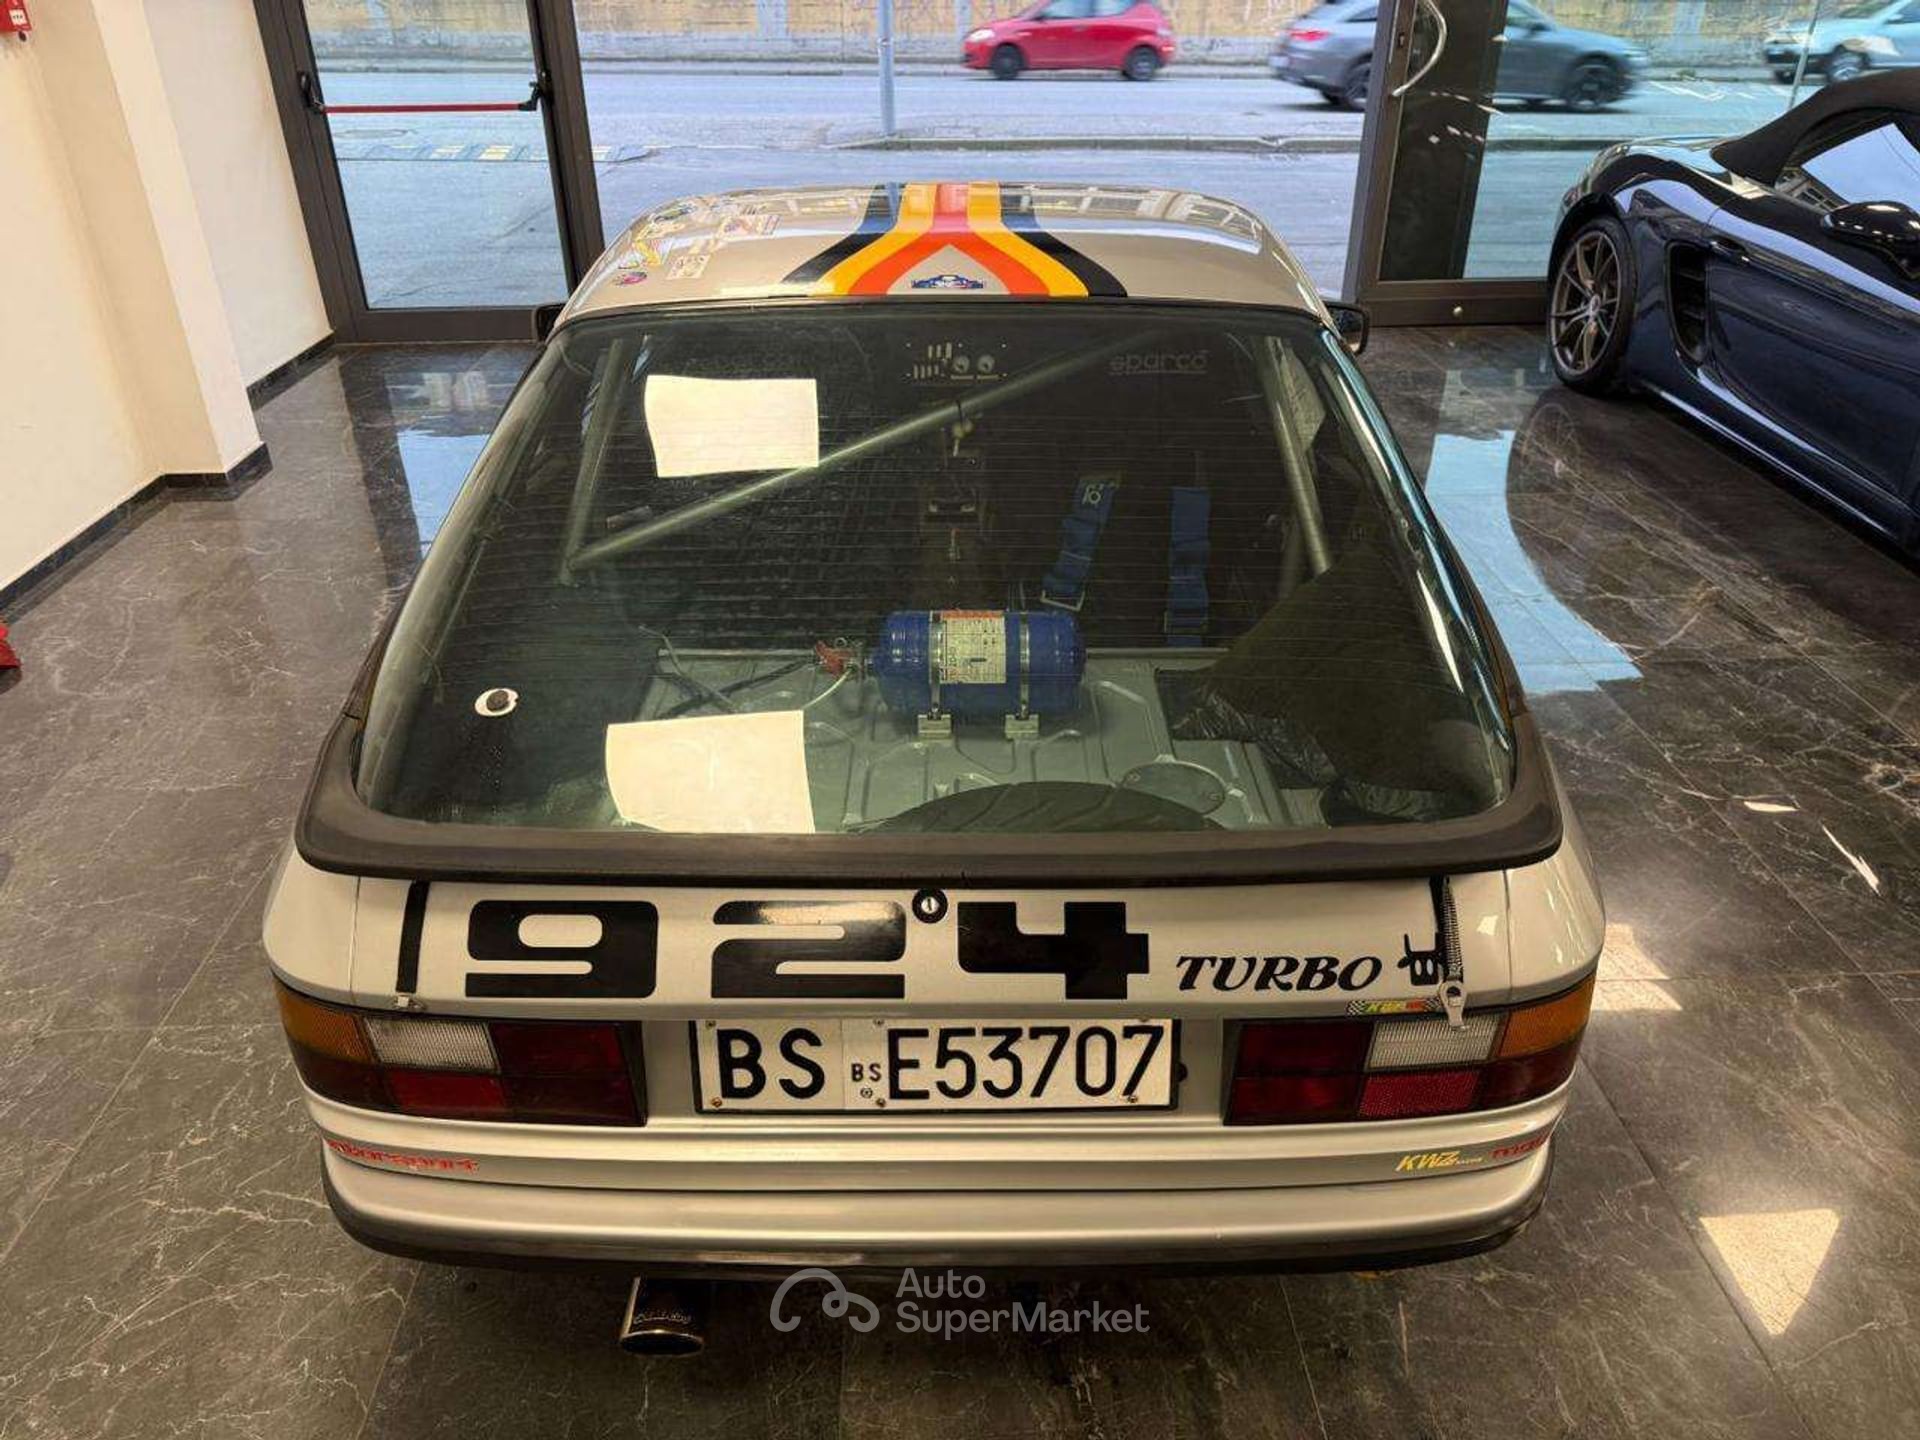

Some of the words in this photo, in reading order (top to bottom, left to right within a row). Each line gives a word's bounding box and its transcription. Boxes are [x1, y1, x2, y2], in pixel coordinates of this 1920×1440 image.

[465, 900, 1149, 999] 924
[1176, 955, 1383, 992] TURBO
[716, 1028, 826, 1100] BS
[887, 1025, 1166, 1100] E53707
[851, 1062, 882, 1082] BS
